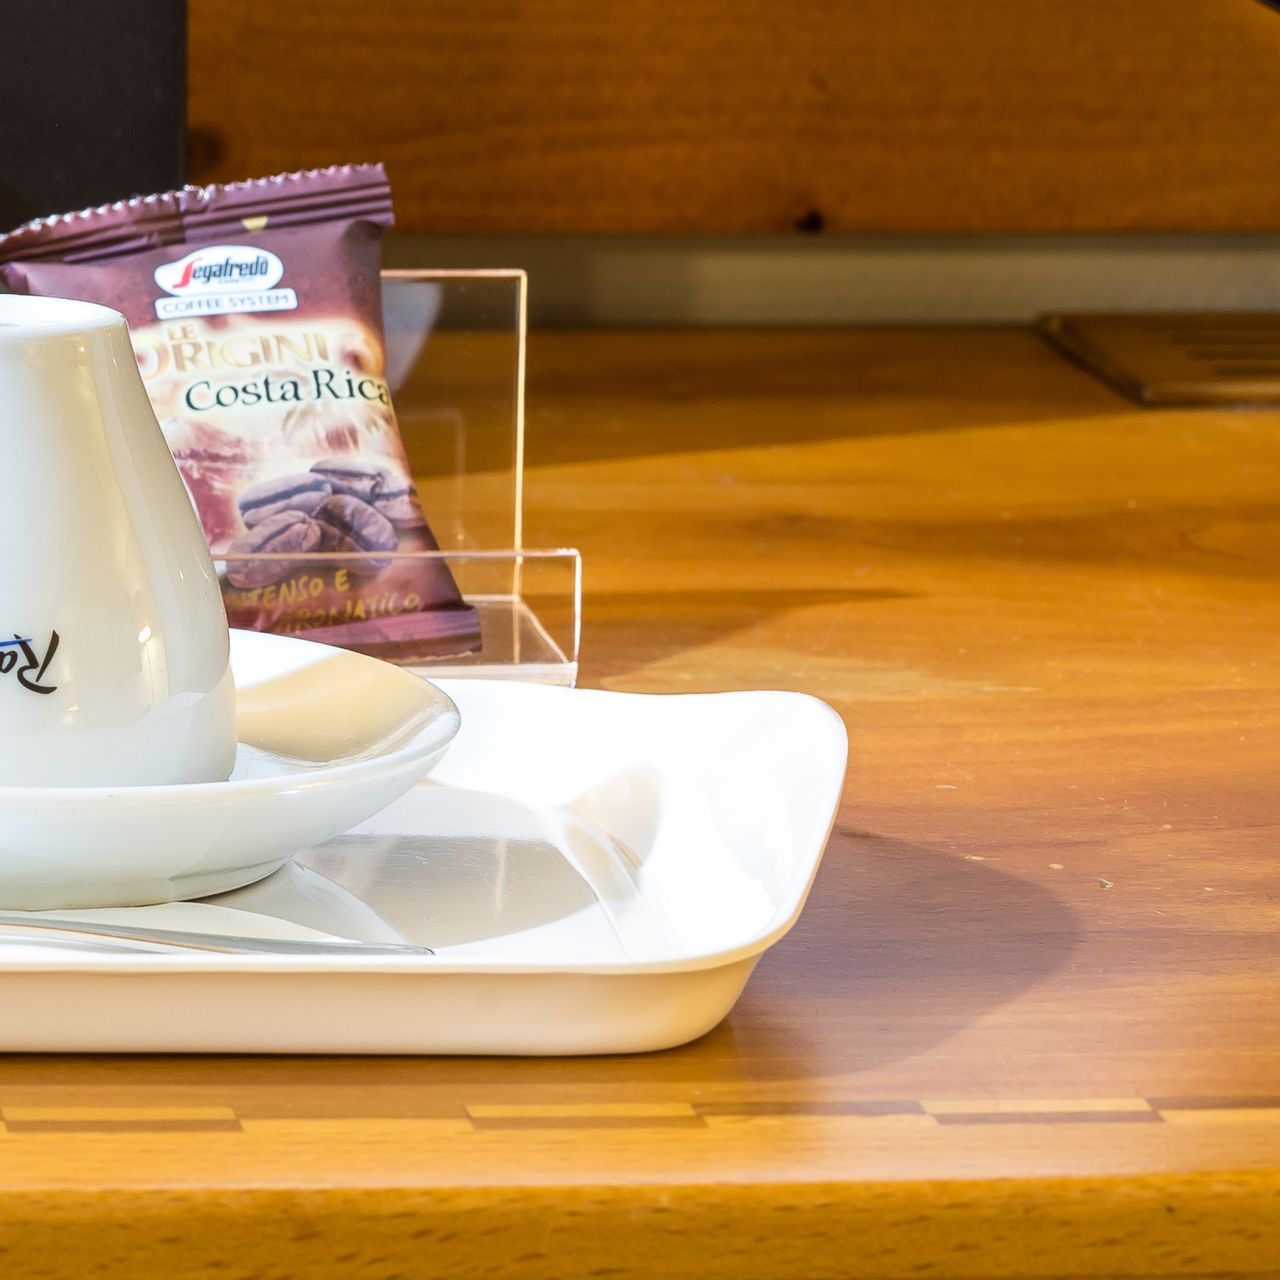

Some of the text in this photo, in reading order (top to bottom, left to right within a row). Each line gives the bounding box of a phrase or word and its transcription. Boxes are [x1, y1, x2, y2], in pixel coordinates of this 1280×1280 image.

[172, 255, 269, 288] Segafredo
[163, 293, 290, 313] COFFEE SYSTEM
[168, 325, 197, 341] LE
[185, 369, 390, 411] Costa Rica
[335, 569, 350, 591] E
